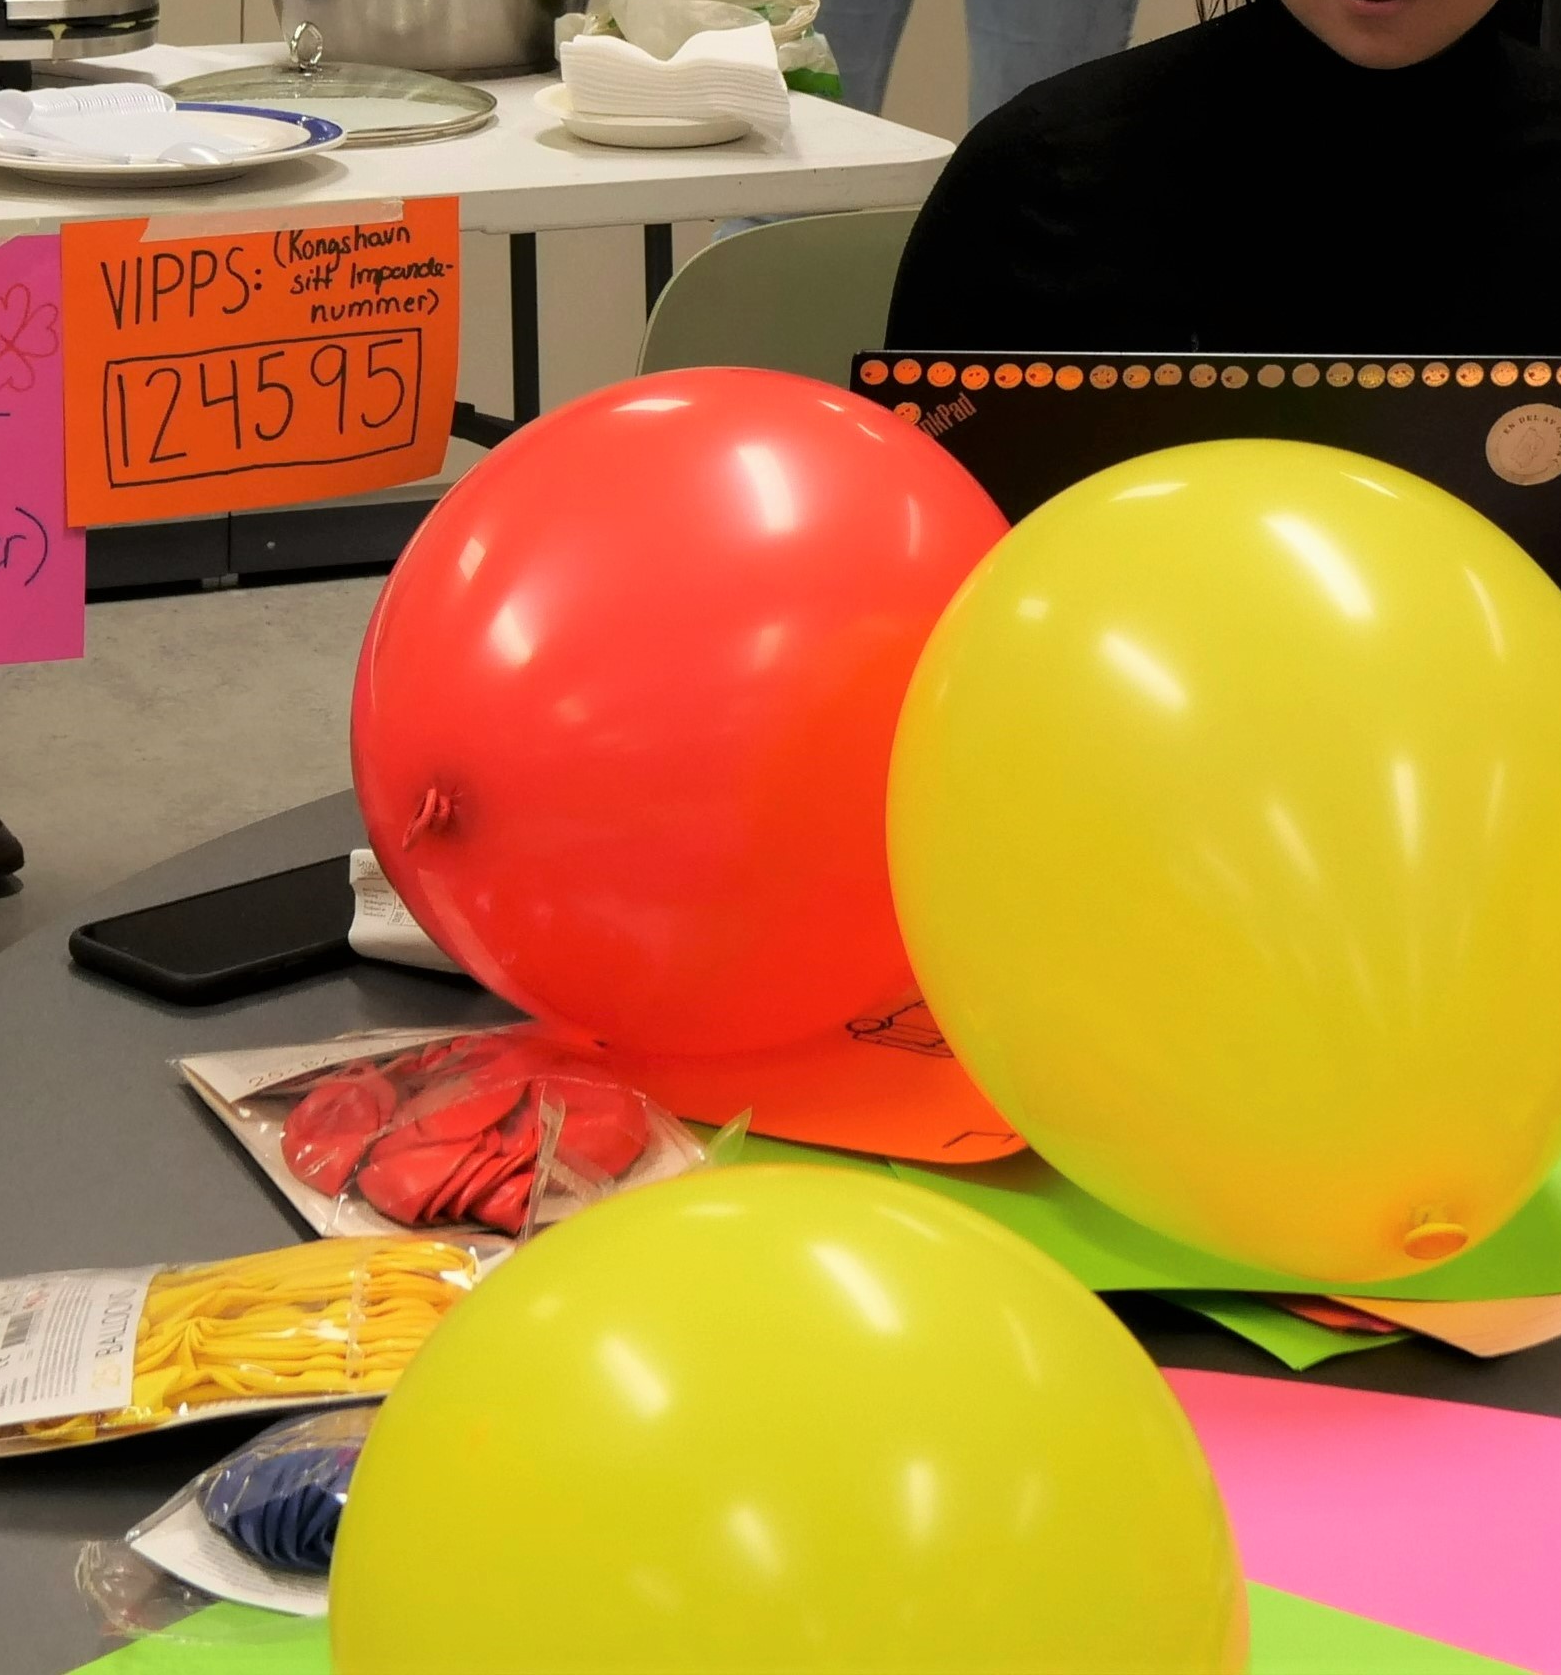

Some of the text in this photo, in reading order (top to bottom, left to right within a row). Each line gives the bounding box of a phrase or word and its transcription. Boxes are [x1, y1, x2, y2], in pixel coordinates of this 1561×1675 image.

[100, 247, 263, 330] VIPPS:
[289, 262, 334, 295] sitt
[310, 287, 440, 324] nummer)
[117, 338, 405, 468] 124595
